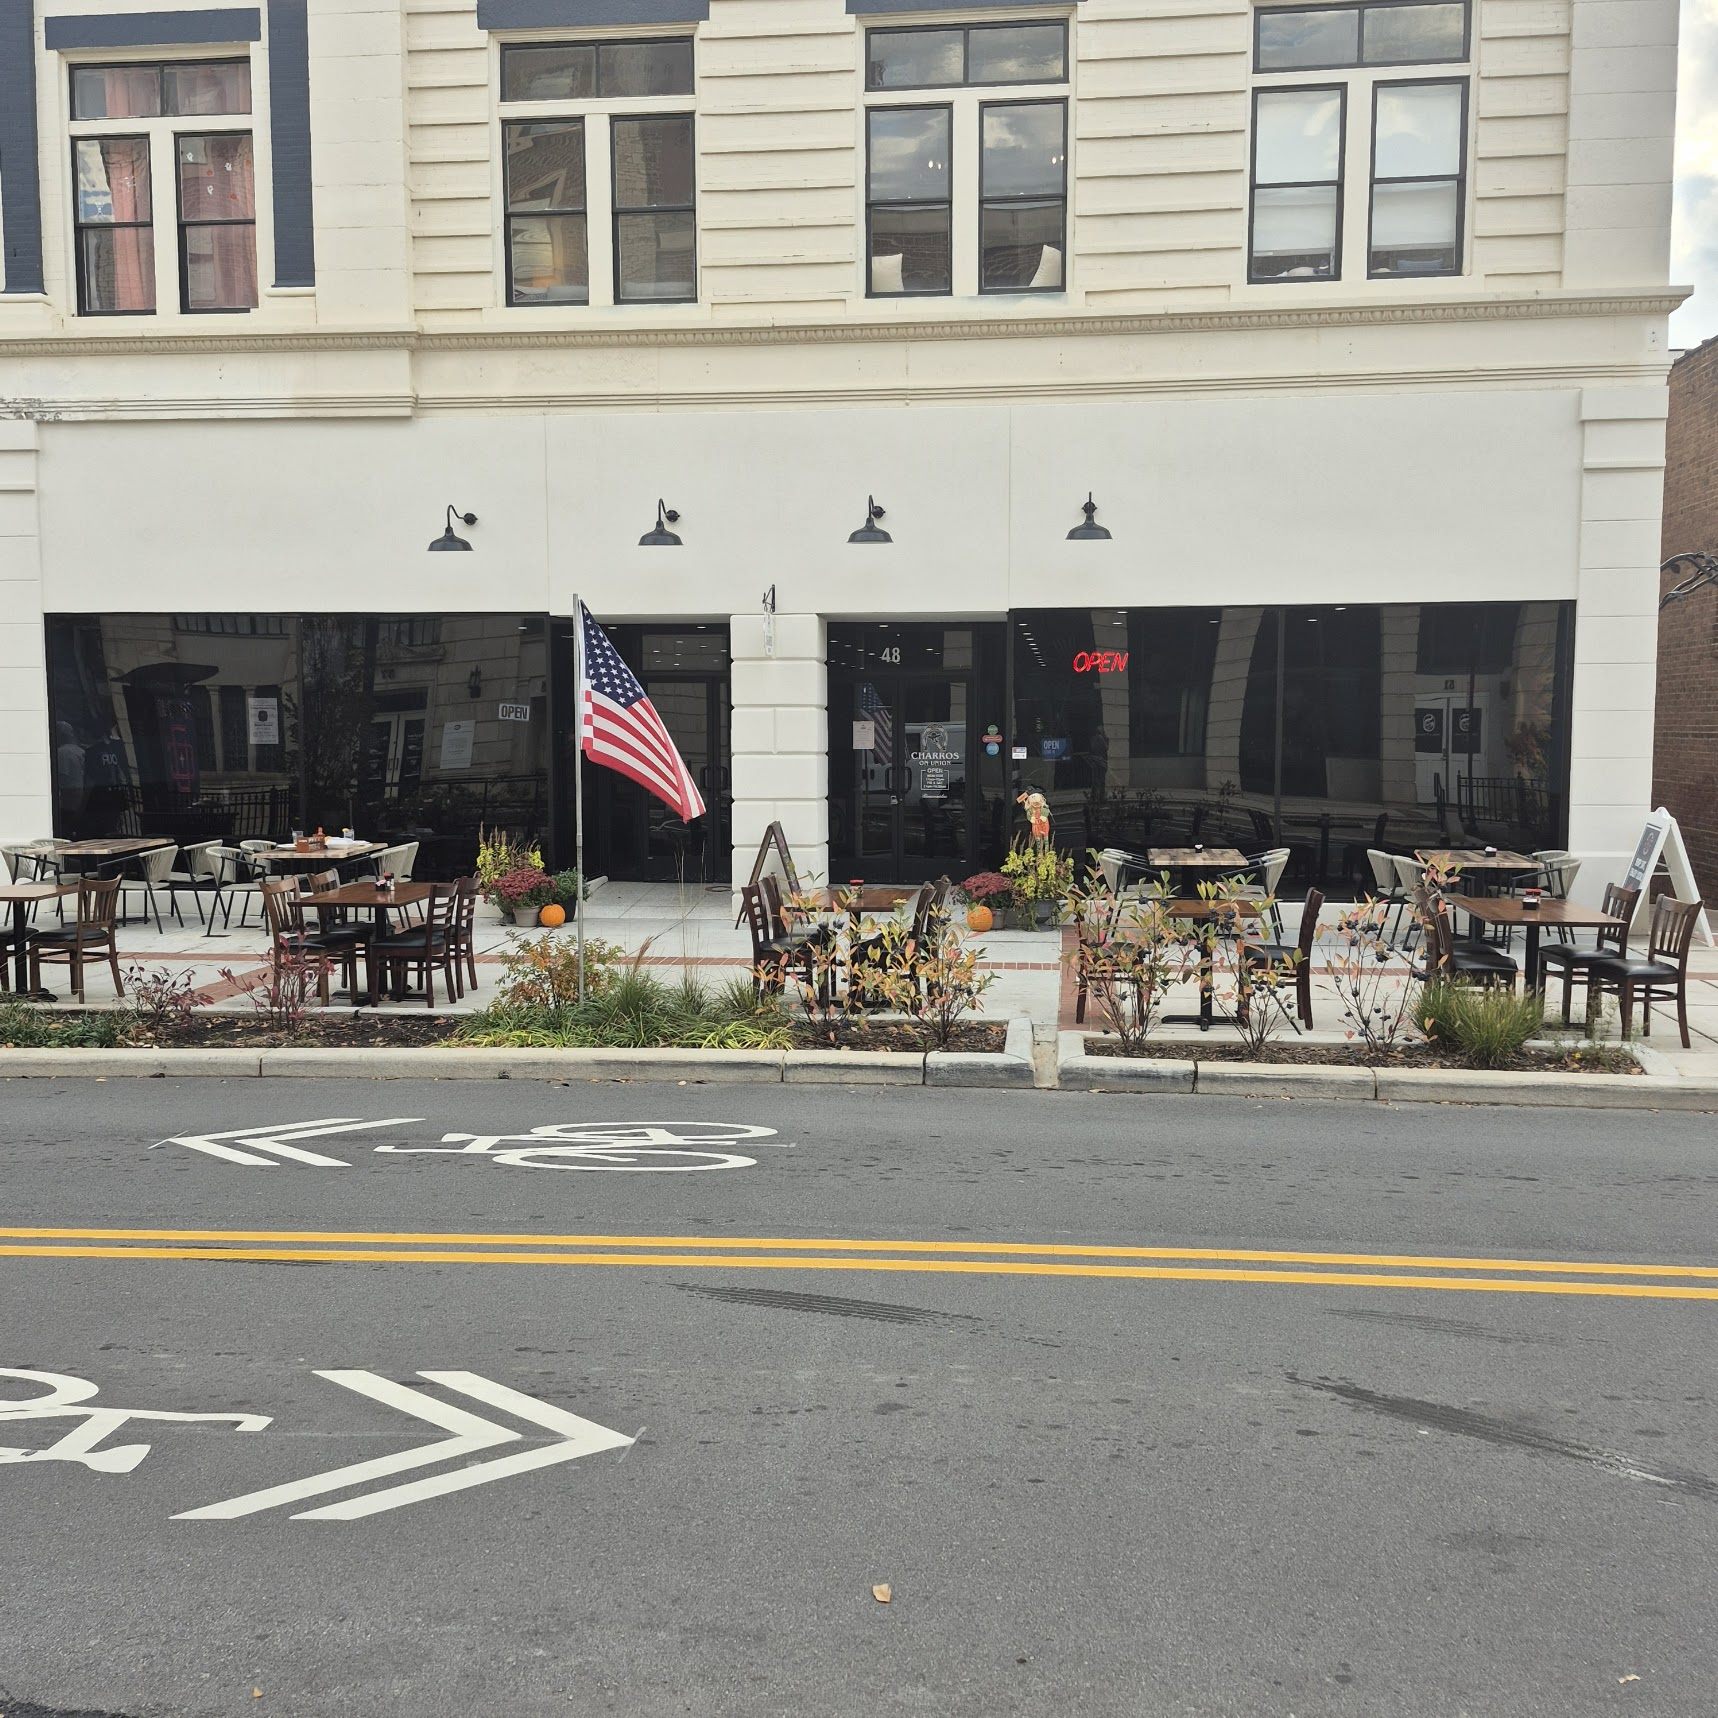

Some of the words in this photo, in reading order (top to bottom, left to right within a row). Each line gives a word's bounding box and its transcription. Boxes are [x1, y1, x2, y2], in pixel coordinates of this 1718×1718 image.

[881, 647, 901, 663] 48
[1073, 651, 1129, 673] OPEN
[501, 705, 528, 720] OPEN
[1043, 740, 1060, 750] OPEN
[910, 751, 960, 760] CHARROS
